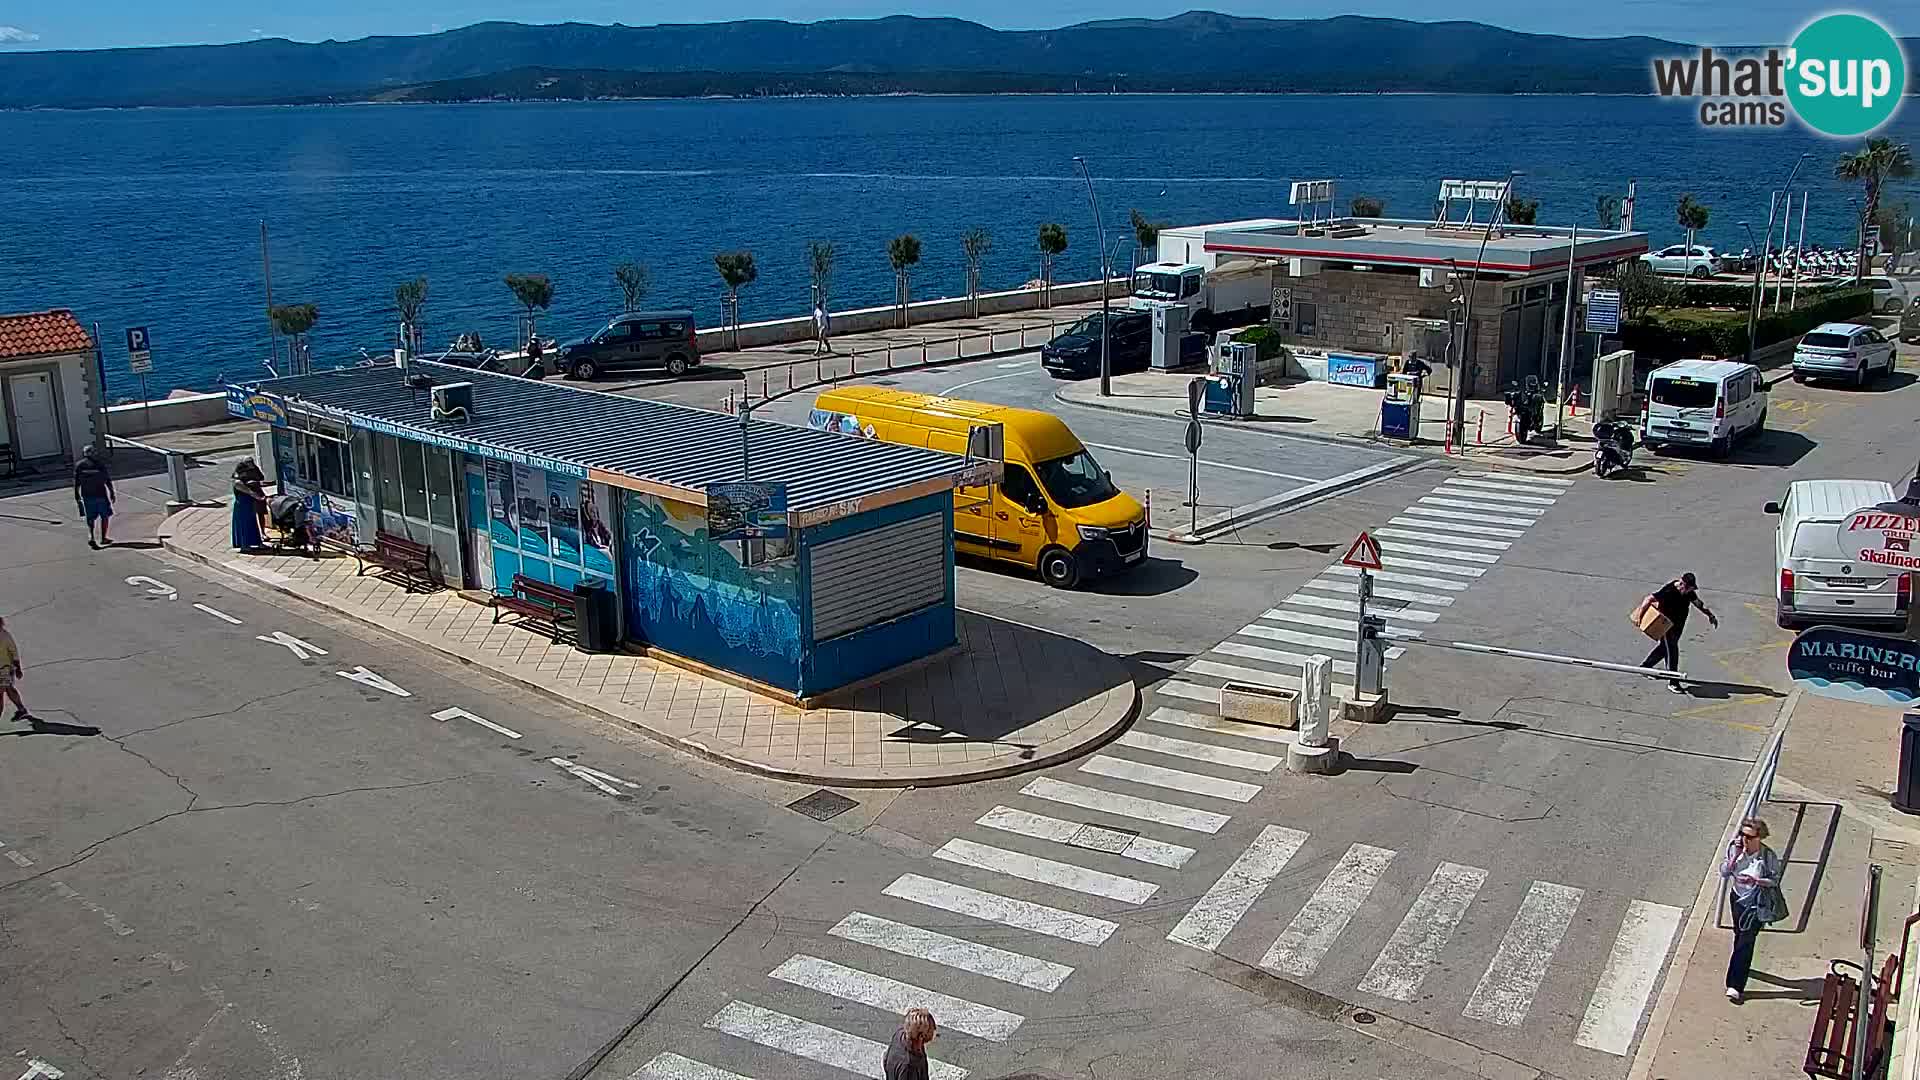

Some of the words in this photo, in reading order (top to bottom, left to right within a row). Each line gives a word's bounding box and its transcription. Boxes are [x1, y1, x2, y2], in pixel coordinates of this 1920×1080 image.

[131, 330, 143, 349] P
[437, 436, 469, 452] POSTAJA
[479, 446, 494, 457] BUS
[494, 448, 527, 465] STATION
[529, 456, 554, 471] TICKET
[556, 463, 583, 476] OFFICE
[1882, 529, 1917, 541] GRILL
[1828, 661, 1865, 675] caffe
[1871, 664, 1897, 680] bar
